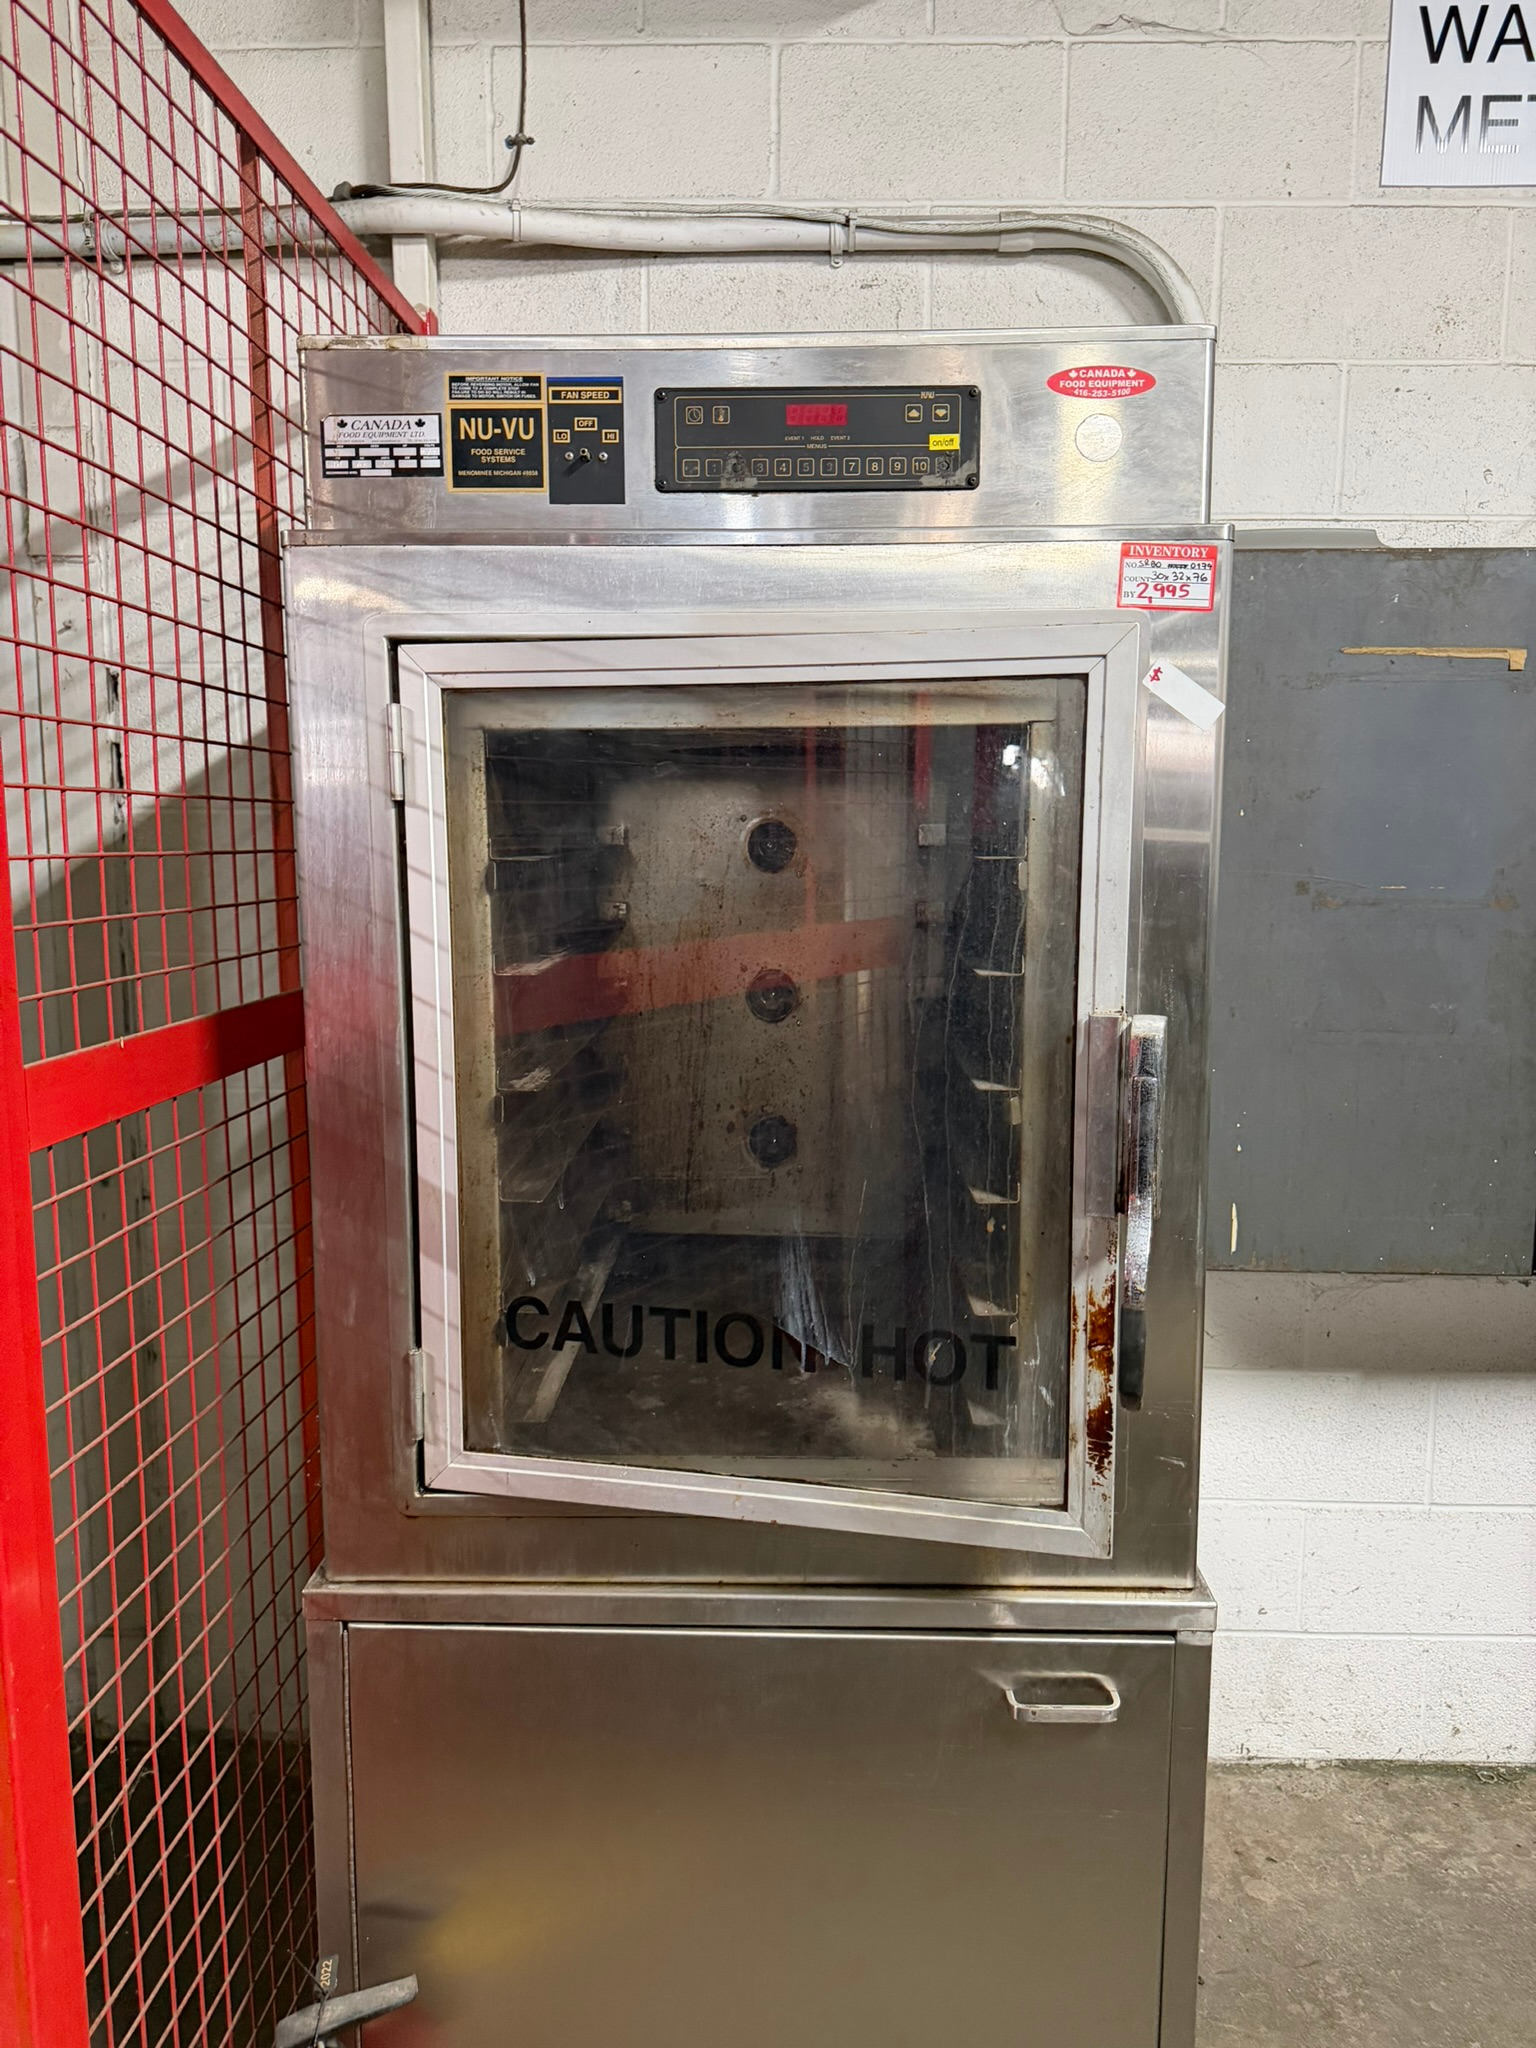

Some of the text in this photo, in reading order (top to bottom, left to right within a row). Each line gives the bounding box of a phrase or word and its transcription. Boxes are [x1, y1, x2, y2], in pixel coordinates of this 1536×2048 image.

[1419, 4, 1536, 64] WA
[1415, 95, 1536, 154] ME
[1079, 369, 1125, 378] CANADA
[1059, 379, 1145, 388] FOOD EQUIPMENT
[561, 391, 610, 399] FAN SPEED
[351, 419, 411, 431] CANADA
[460, 417, 535, 440] NU-VU
[338, 431, 361, 439] FOOD
[362, 431, 408, 439] EQUIPMENT
[932, 438, 955, 447] on/off
[481, 455, 516, 463] SYSTEMS
[848, 462, 856, 472] 7
[871, 462, 879, 472] 8
[894, 461, 901, 471] 9
[914, 461, 927, 471] 10
[1128, 544, 1209, 558] INVENTORY
[1123, 590, 1136, 598] BY
[862, 1323, 1017, 1391] HOT
[320, 1959, 333, 1989] 2022
